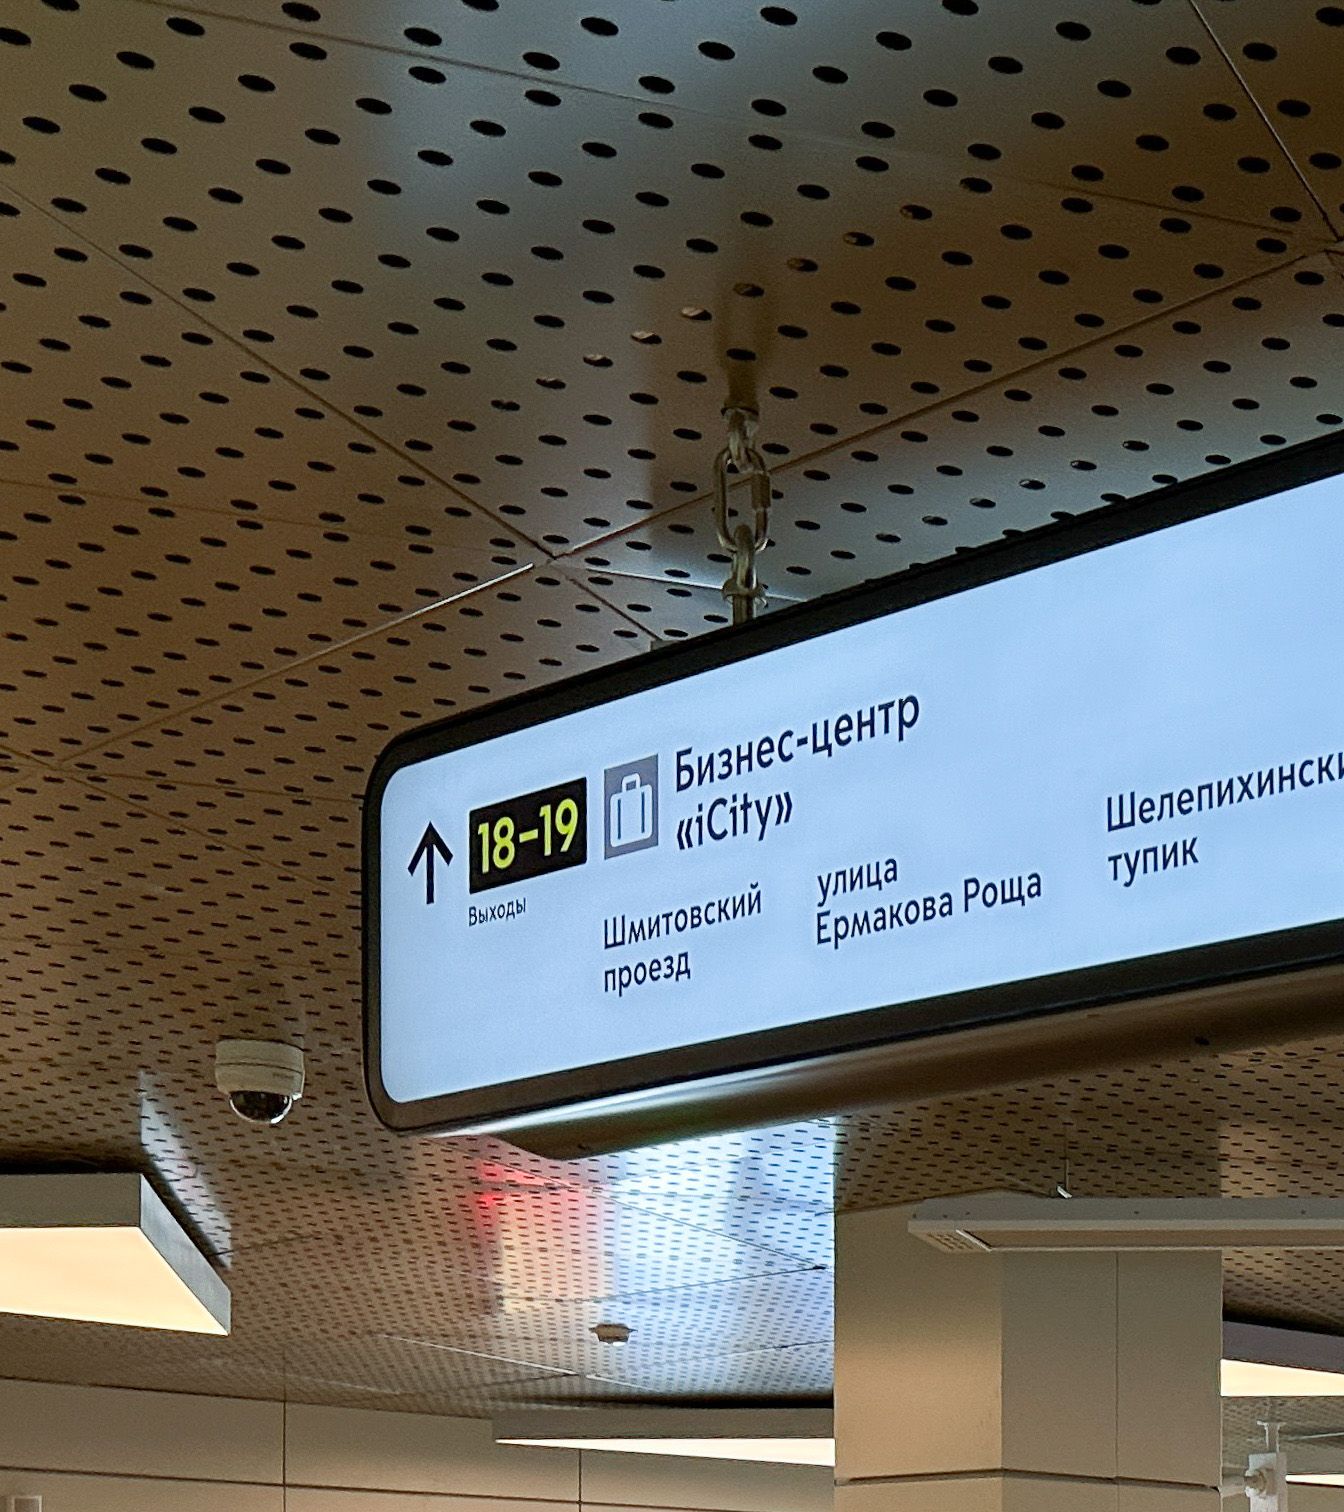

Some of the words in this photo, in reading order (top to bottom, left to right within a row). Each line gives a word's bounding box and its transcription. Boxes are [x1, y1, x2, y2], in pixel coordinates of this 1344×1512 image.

[677, 696, 920, 792] Бизнес-центр
[677, 792, 793, 850] «iCity»
[818, 856, 897, 907] улица
[1108, 837, 1199, 887] тупик
[469, 898, 526, 926] Выходы
[605, 882, 761, 949] Шмитовский
[817, 890, 953, 947] Ермакова
[964, 868, 1041, 917] Роща
[605, 952, 691, 997] проезд
